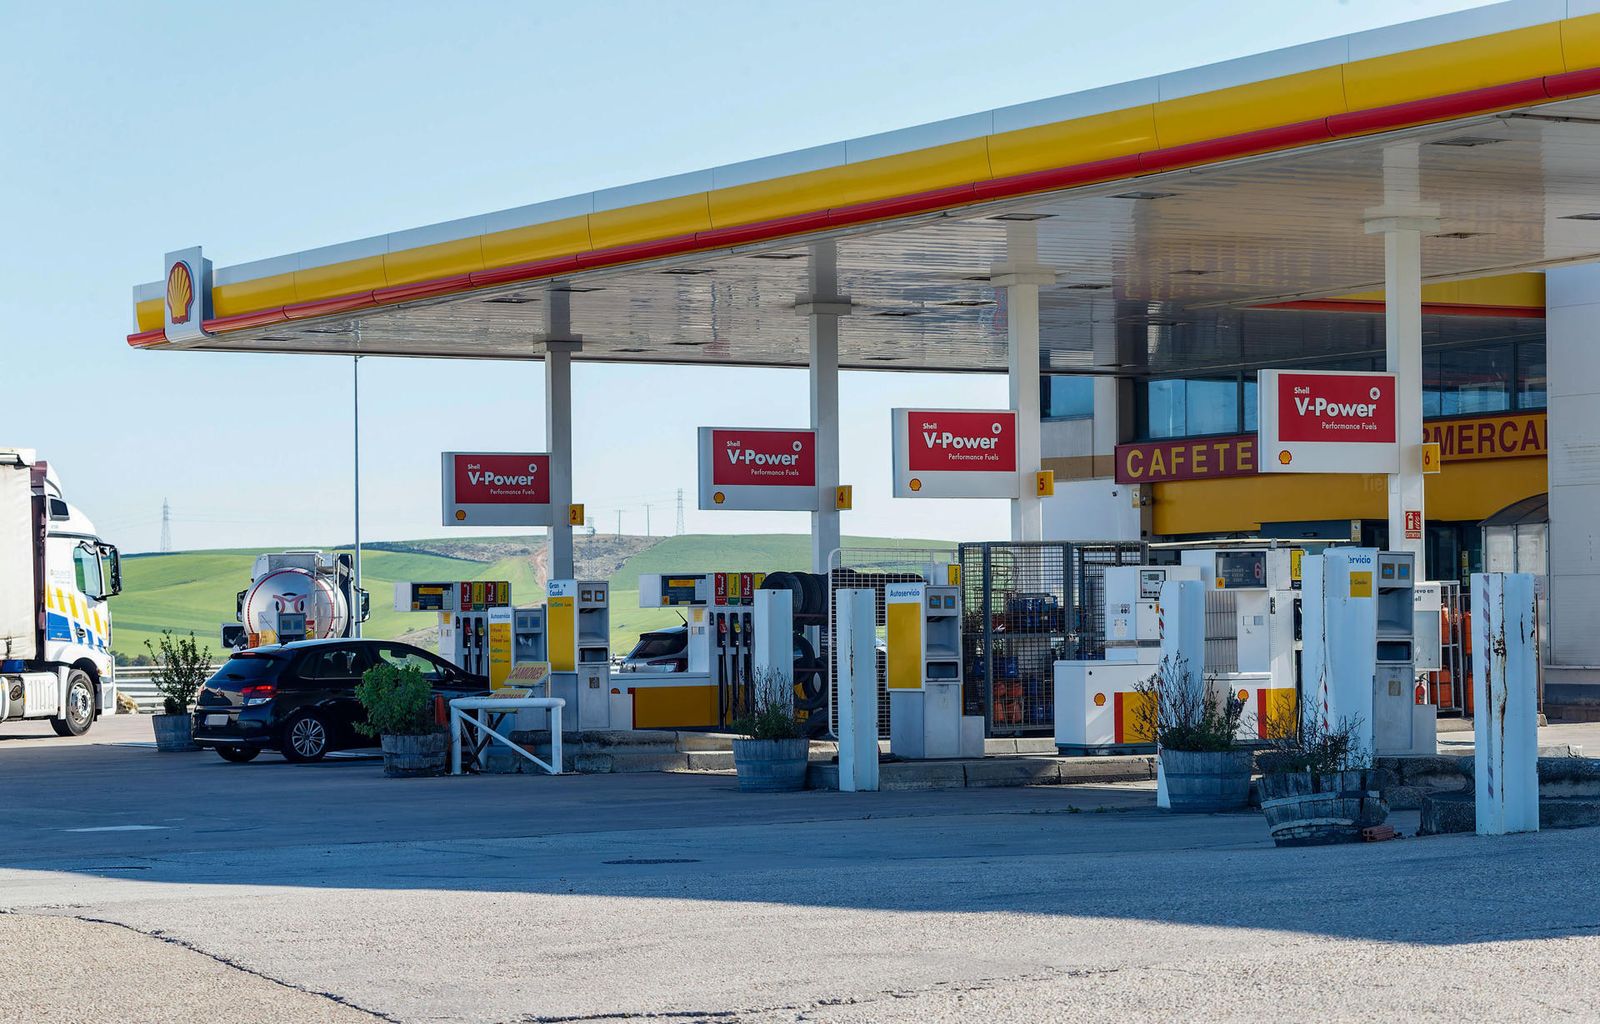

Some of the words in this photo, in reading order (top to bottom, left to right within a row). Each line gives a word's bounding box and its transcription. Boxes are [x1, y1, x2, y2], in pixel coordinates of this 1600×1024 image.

[1294, 397, 1377, 417] V-Power
[1321, 421, 1361, 430] Performance
[1361, 422, 1377, 430] Fuels
[922, 432, 998, 449] V-Power
[1423, 419, 1547, 455] MERCA
[726, 449, 799, 465] V-Power
[984, 453, 999, 461] Fuels
[1126, 441, 1253, 478] CAFETE
[1424, 451, 1430, 465] 6
[467, 471, 534, 486] V-Power
[751, 468, 785, 476] Performance
[1039, 478, 1045, 490] 5
[838, 492, 844, 503] 4
[571, 510, 577, 520] 2
[1348, 555, 1371, 564] ervicio
[1254, 562, 1262, 579] 6
[890, 589, 920, 597] Autoservicio
